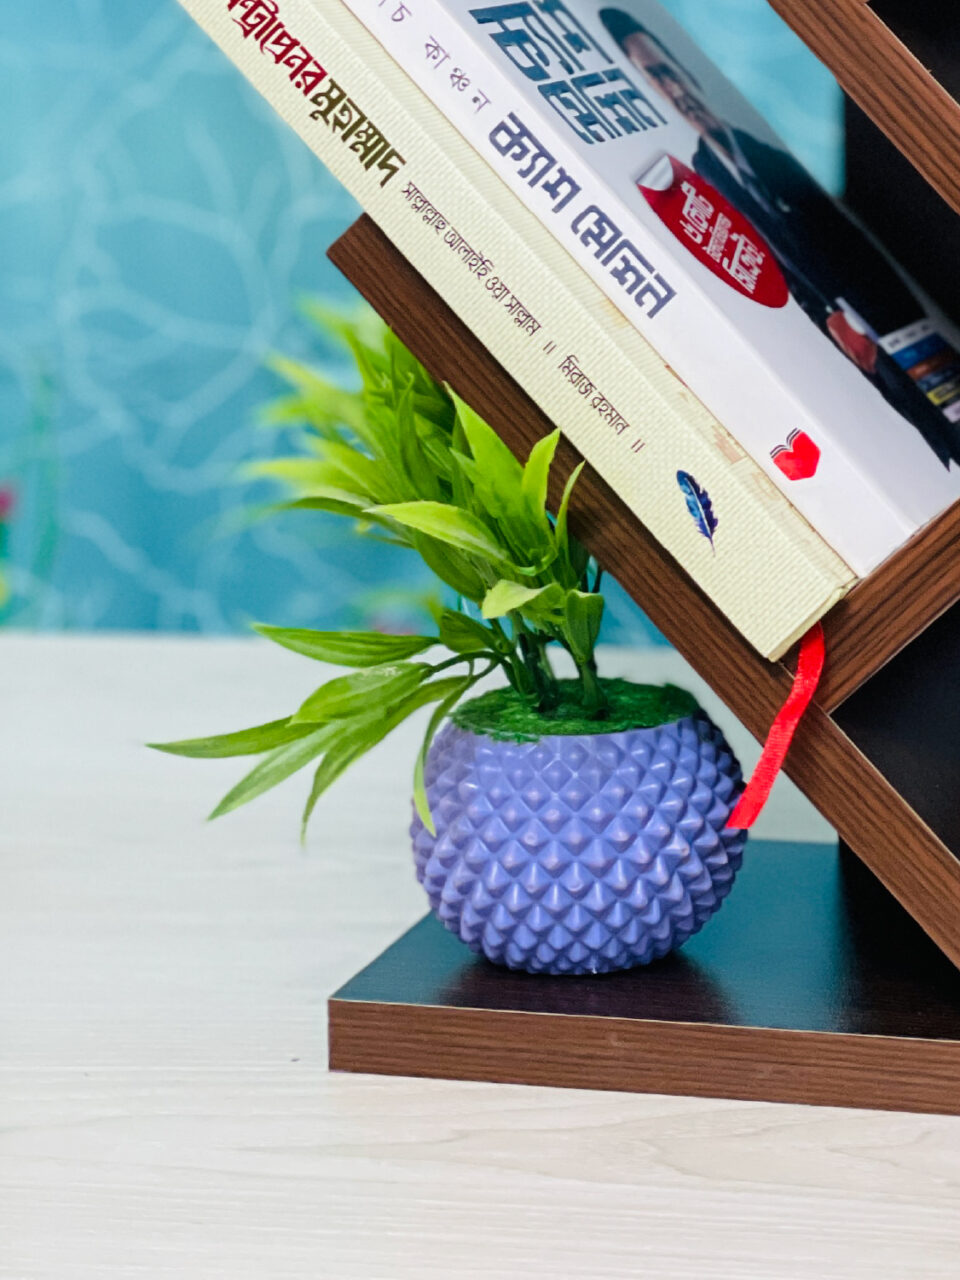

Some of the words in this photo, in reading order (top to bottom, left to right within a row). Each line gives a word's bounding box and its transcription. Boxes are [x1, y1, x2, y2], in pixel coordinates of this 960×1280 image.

[538, 67, 668, 145] মেশিন
[489, 112, 583, 213] ক্যাশ
[570, 204, 677, 319] মেশিন
[504, 294, 542, 337] সাল্লাম
[558, 354, 596, 399] মিরাজ
[591, 391, 630, 435] রহমান
